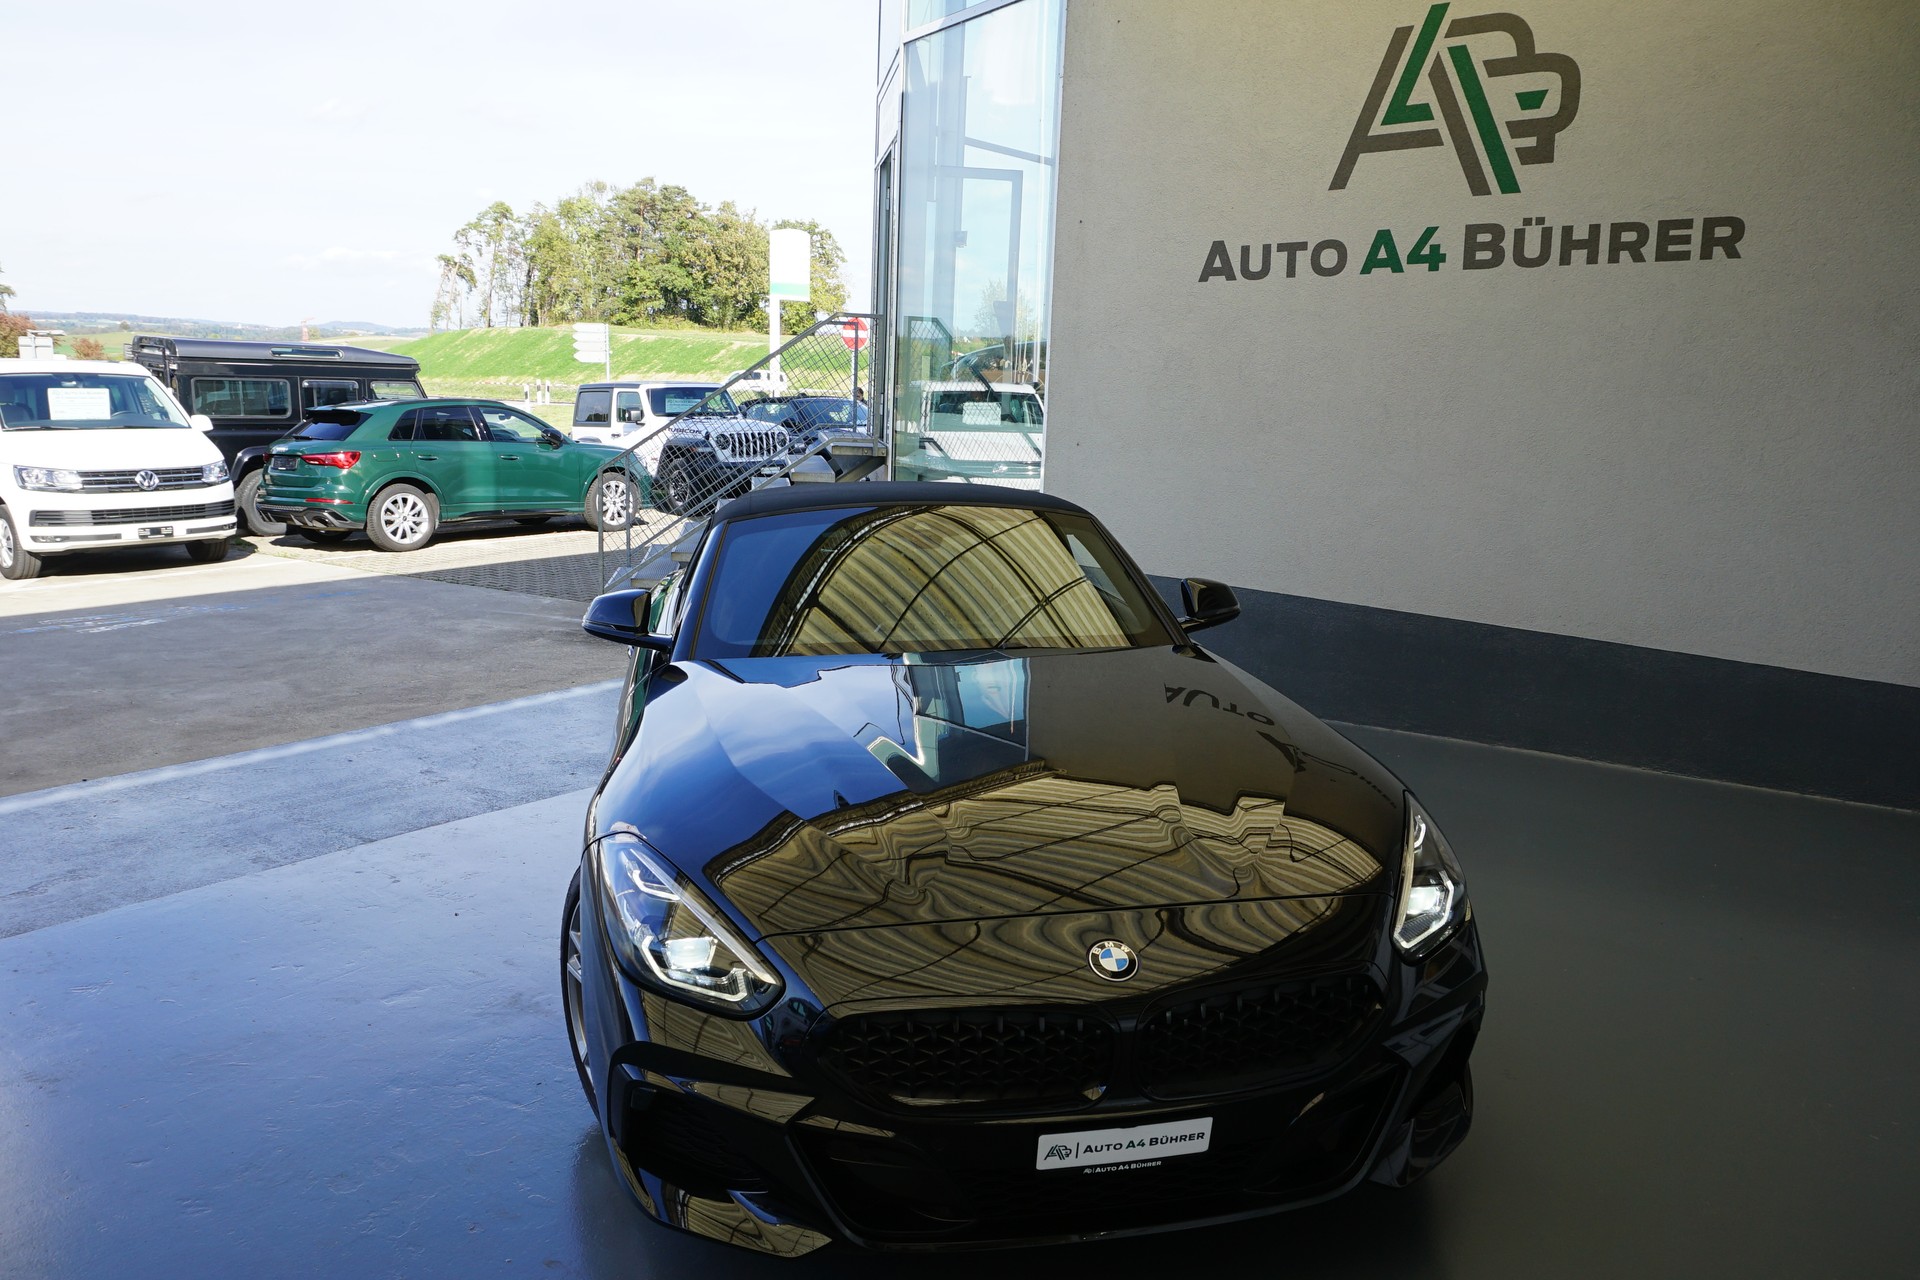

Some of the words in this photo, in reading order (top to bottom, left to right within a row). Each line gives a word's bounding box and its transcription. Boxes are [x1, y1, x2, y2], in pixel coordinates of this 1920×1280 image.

[1198, 239, 1348, 282] AUTO
[1360, 226, 1446, 274] A4
[1462, 216, 1745, 271] BÜHRER
[1083, 1142, 1122, 1154] AUTO
[1126, 1139, 1145, 1150] A4
[1149, 1132, 1205, 1146] BÜHRER
